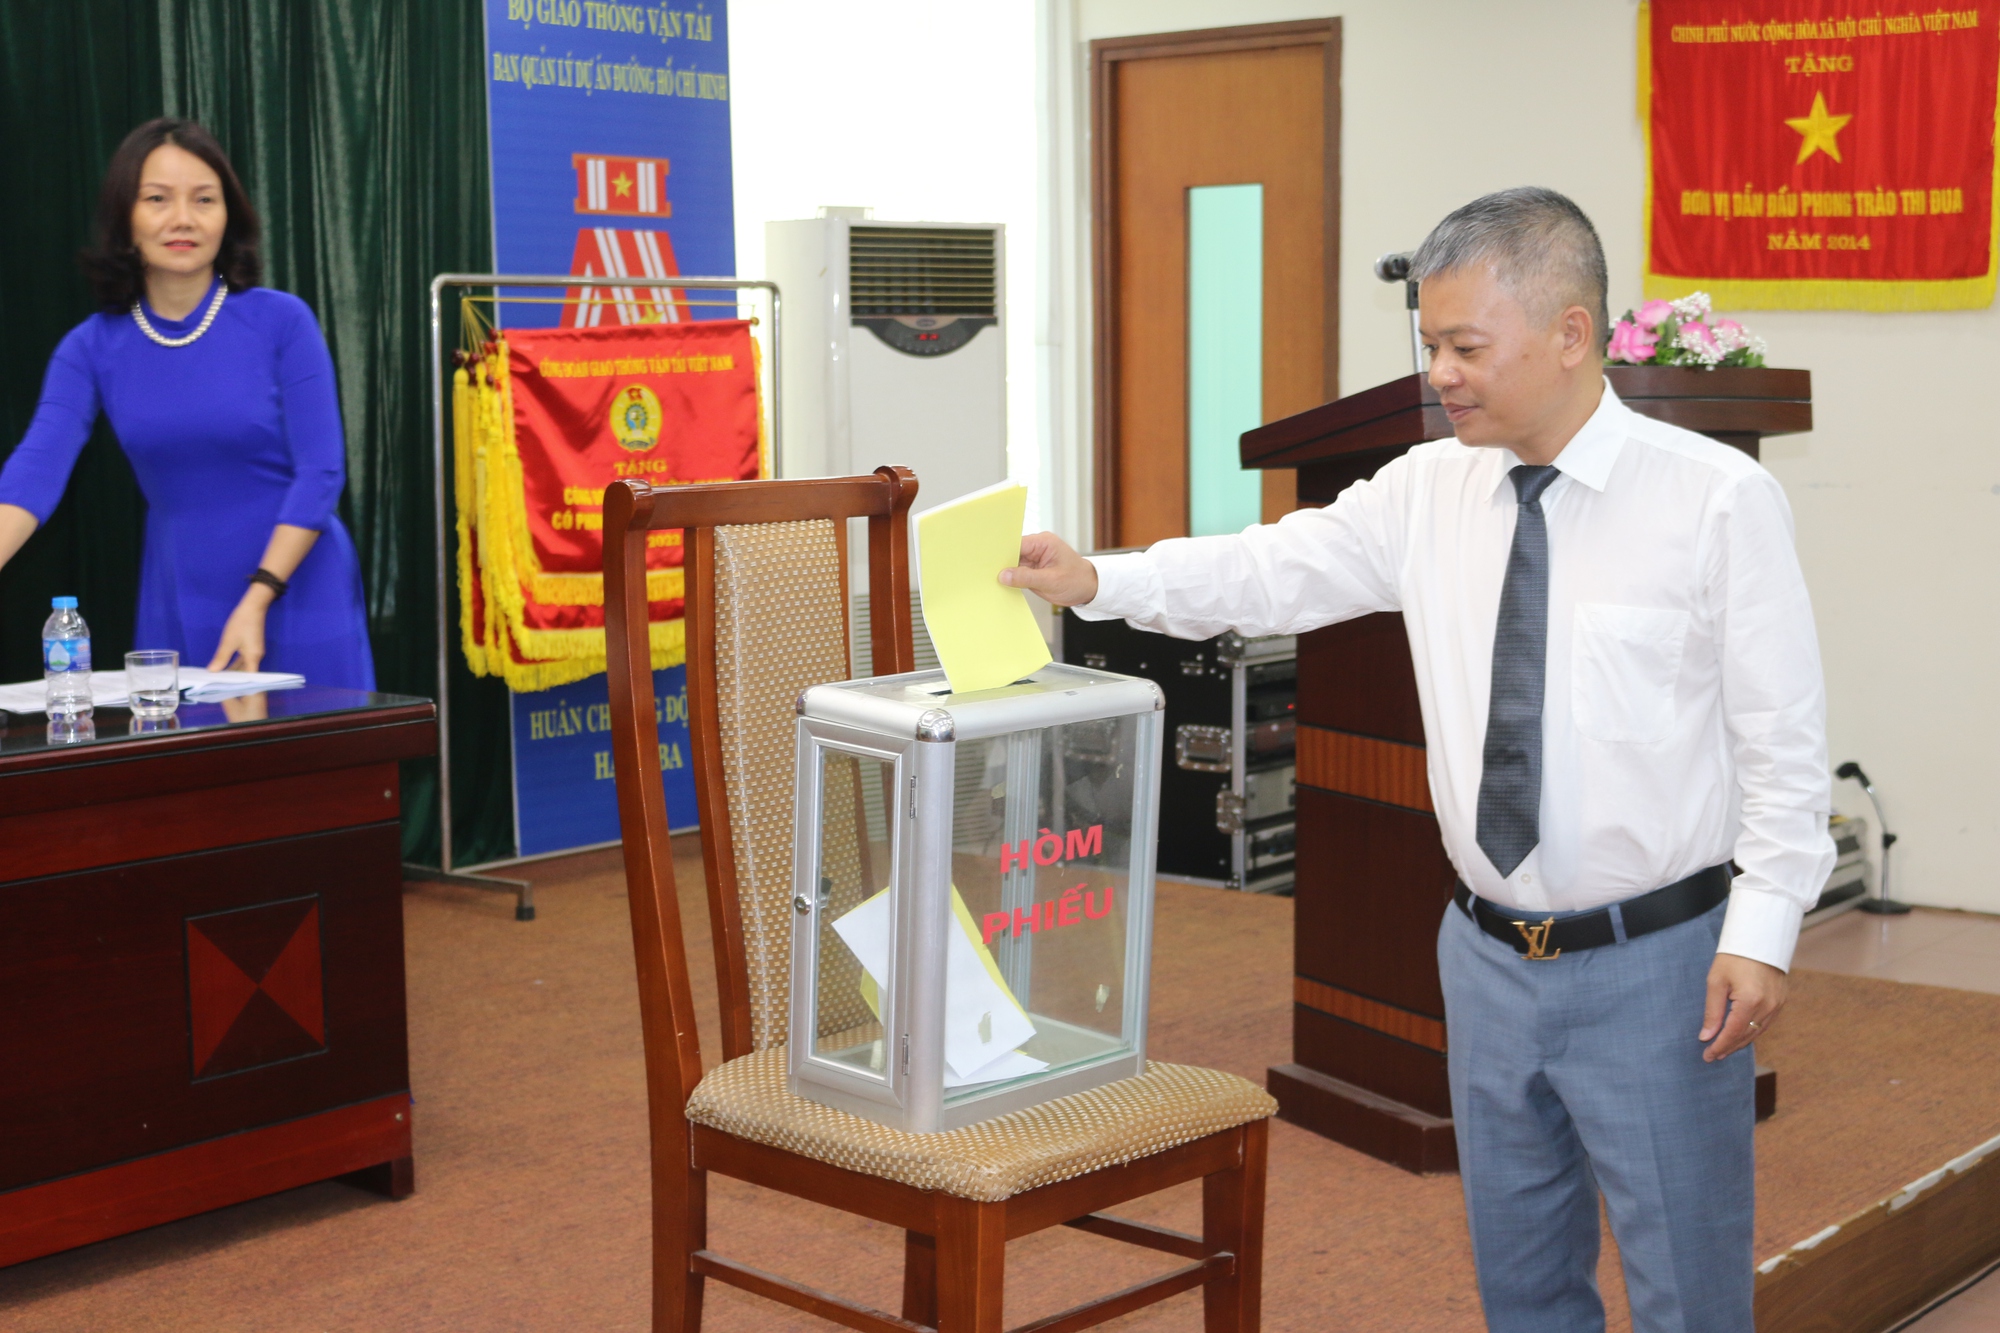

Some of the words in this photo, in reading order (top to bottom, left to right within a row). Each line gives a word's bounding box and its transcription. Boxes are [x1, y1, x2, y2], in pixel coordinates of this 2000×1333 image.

[536, 0, 581, 27] GIAO
[583, 0, 645, 34] THÔNG
[646, 1, 682, 44] VẬN
[683, 3, 713, 42] TẢI
[1706, 17, 1729, 43] PHỦ
[1731, 19, 1760, 42] NƯỚC
[1762, 17, 1793, 45] CỘNG
[1795, 17, 1818, 40] HÒA
[1836, 14, 1857, 42] HỘI
[1858, 10, 1882, 36] CHỦ
[1922, 7, 1950, 36] VIỆT
[1951, 9, 1979, 29] NAM
[493, 52, 520, 83] BAN
[521, 44, 558, 90] QUẢN
[594, 53, 612, 91] ÁN
[656, 56, 674, 96] HỒ
[675, 64, 697, 98] CHÍ
[697, 72, 727, 101] MINH
[1785, 52, 1853, 77] TẶNG
[1713, 192, 1730, 221] VỊ
[1800, 191, 1852, 217] PHONG
[1854, 186, 1897, 217] TRÀO
[1899, 188, 1926, 216] THI
[1929, 187, 1963, 215] ĐUA
[1767, 229, 1822, 250] NĂM
[1827, 234, 1871, 250] 2014
[709, 354, 733, 371] NAM
[530, 699, 582, 740] HUÂN
[1000, 824, 1103, 874] HÒM
[982, 883, 1114, 945] PHIẾU
